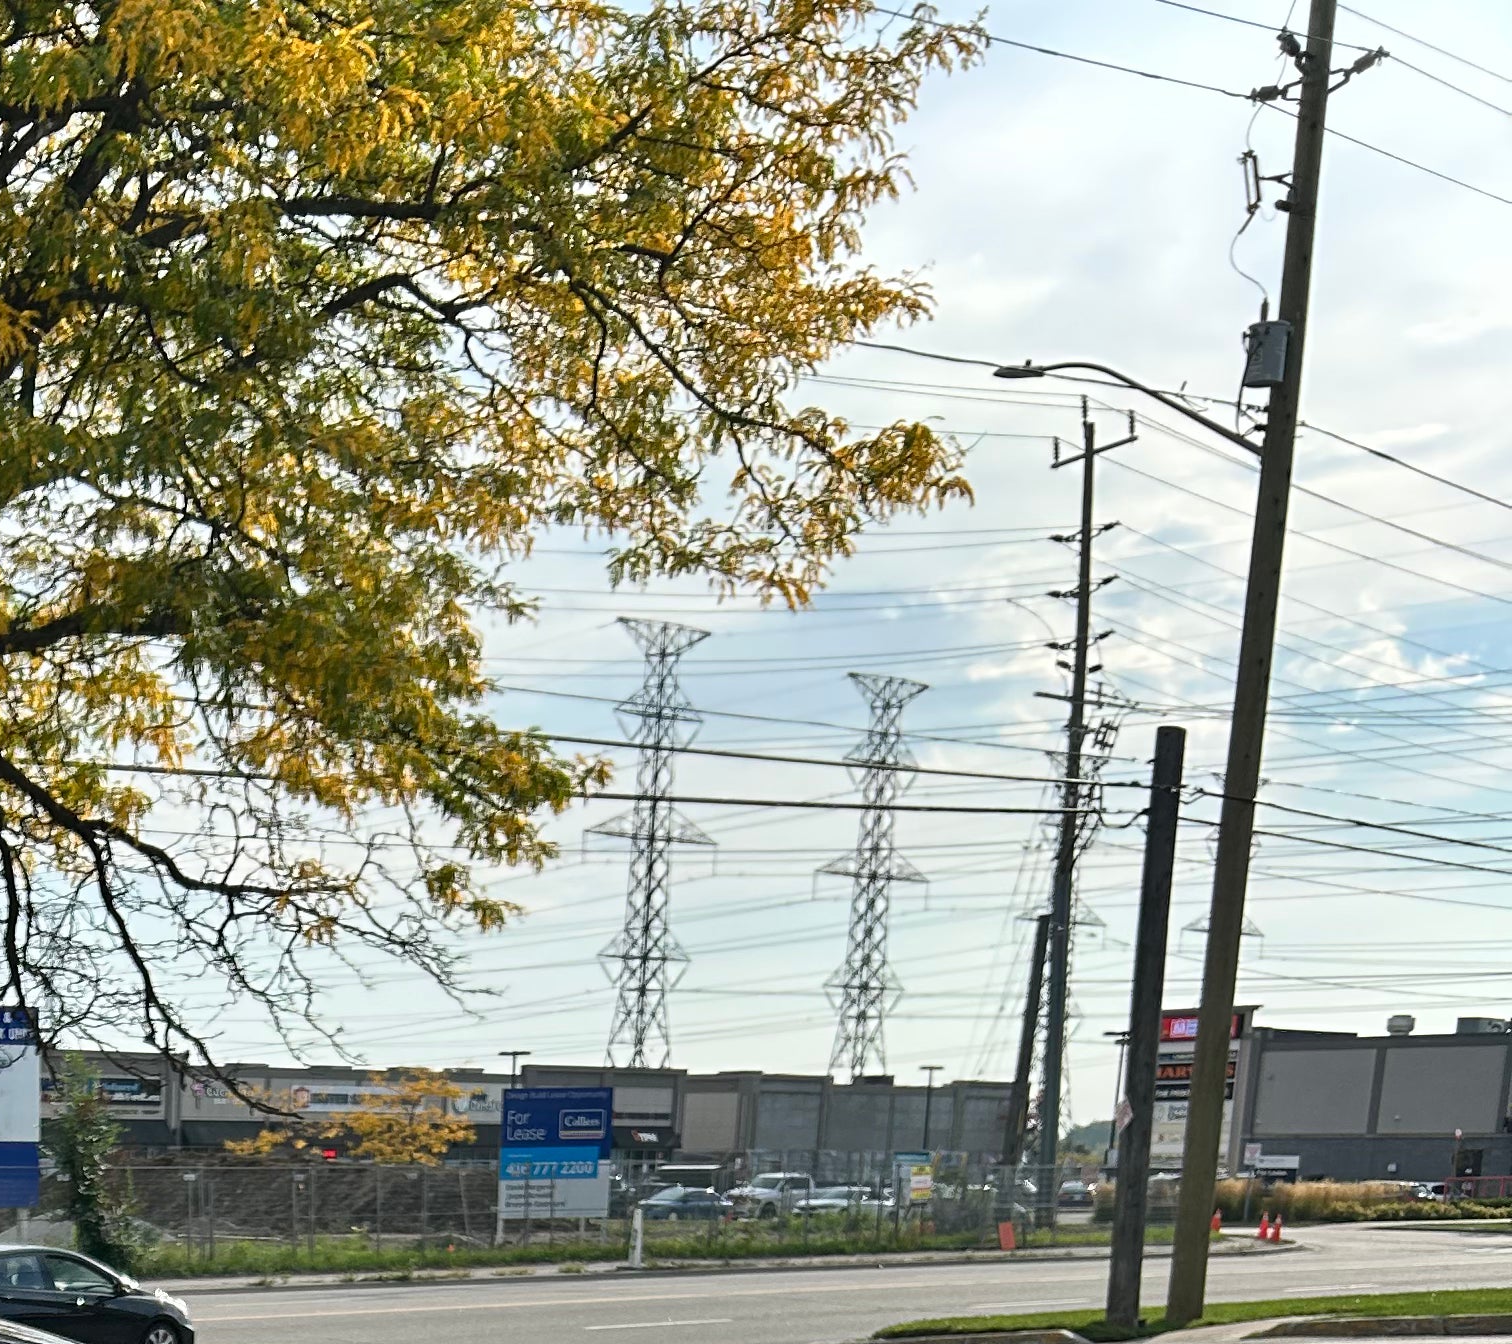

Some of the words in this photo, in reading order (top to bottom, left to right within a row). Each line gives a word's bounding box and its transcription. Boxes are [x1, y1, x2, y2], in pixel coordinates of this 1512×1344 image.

[507, 1110, 532, 1125] For
[506, 1126, 548, 1141] Lease
[533, 1161, 558, 1175] 777
